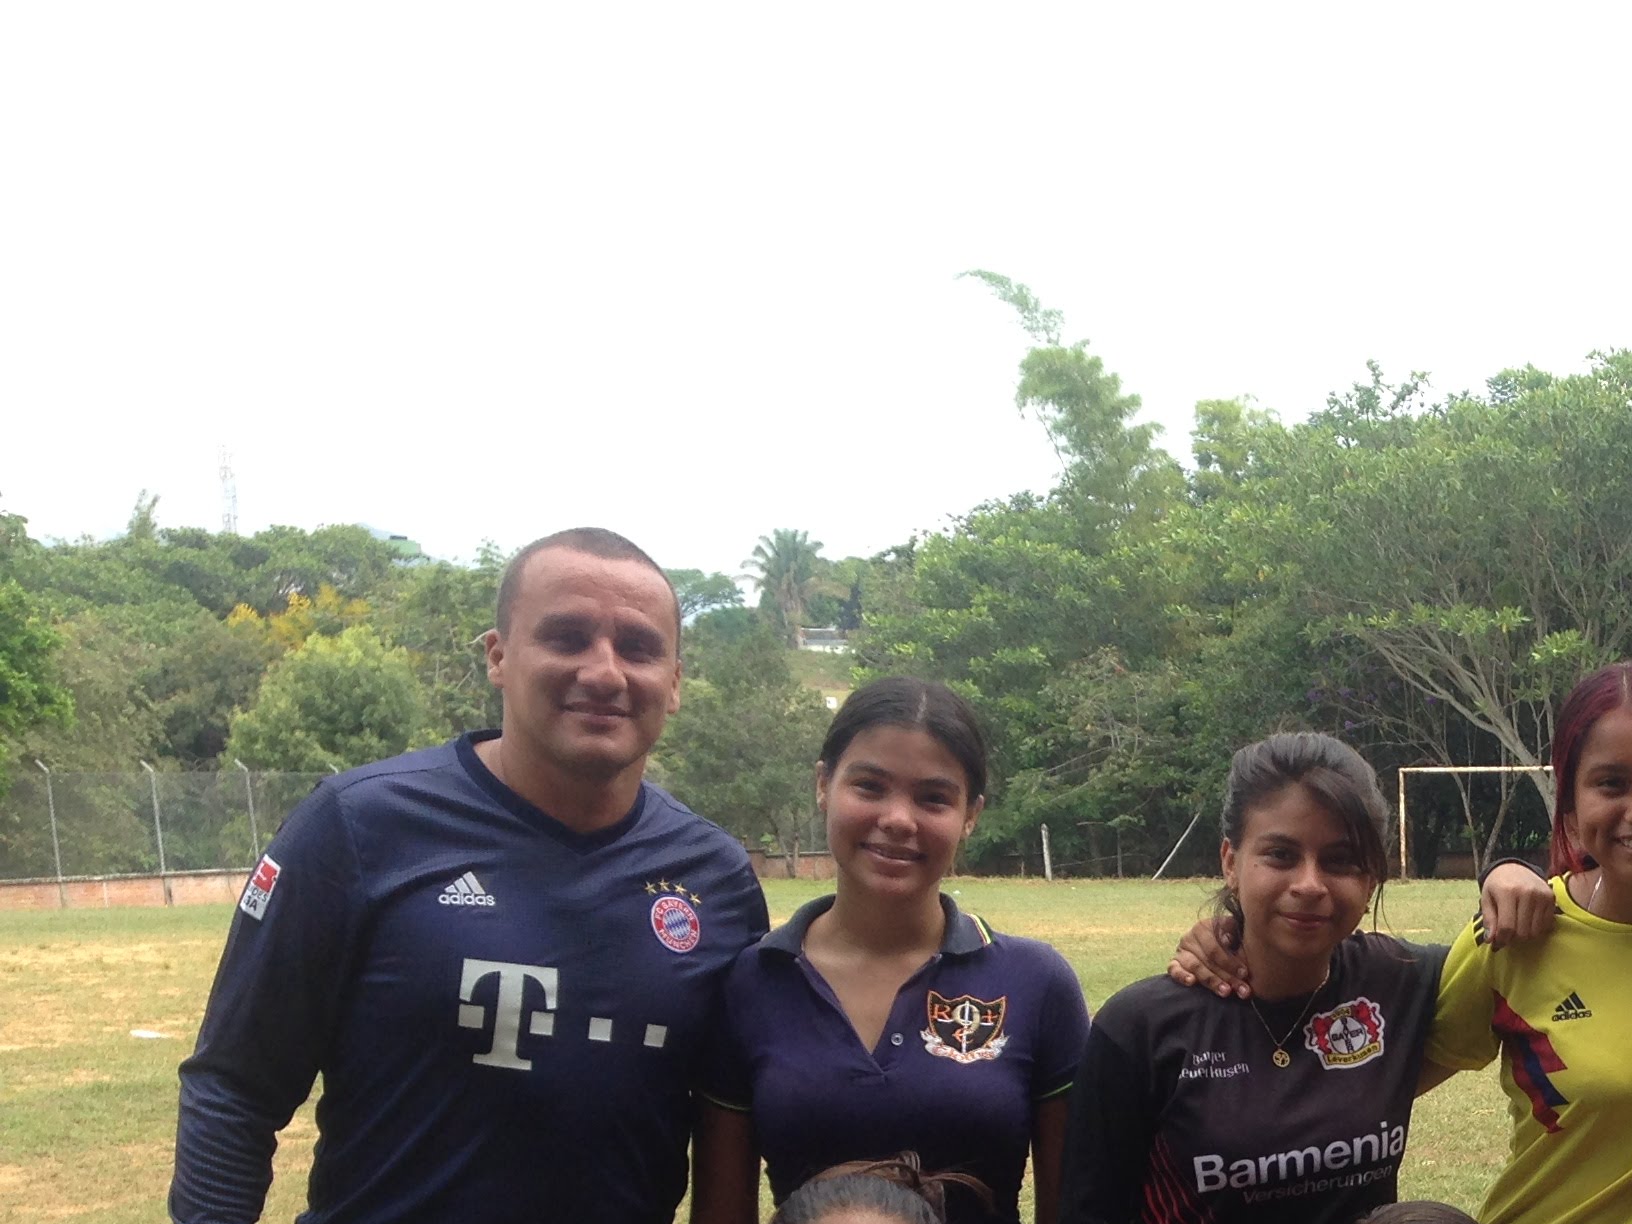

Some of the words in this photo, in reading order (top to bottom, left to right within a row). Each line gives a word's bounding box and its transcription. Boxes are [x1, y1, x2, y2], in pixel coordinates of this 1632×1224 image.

[438, 892, 496, 906] adidas
[458, 958, 559, 1071] T
[1551, 1009, 1593, 1022] adidas
[1193, 1121, 1404, 1193] Barmenia
